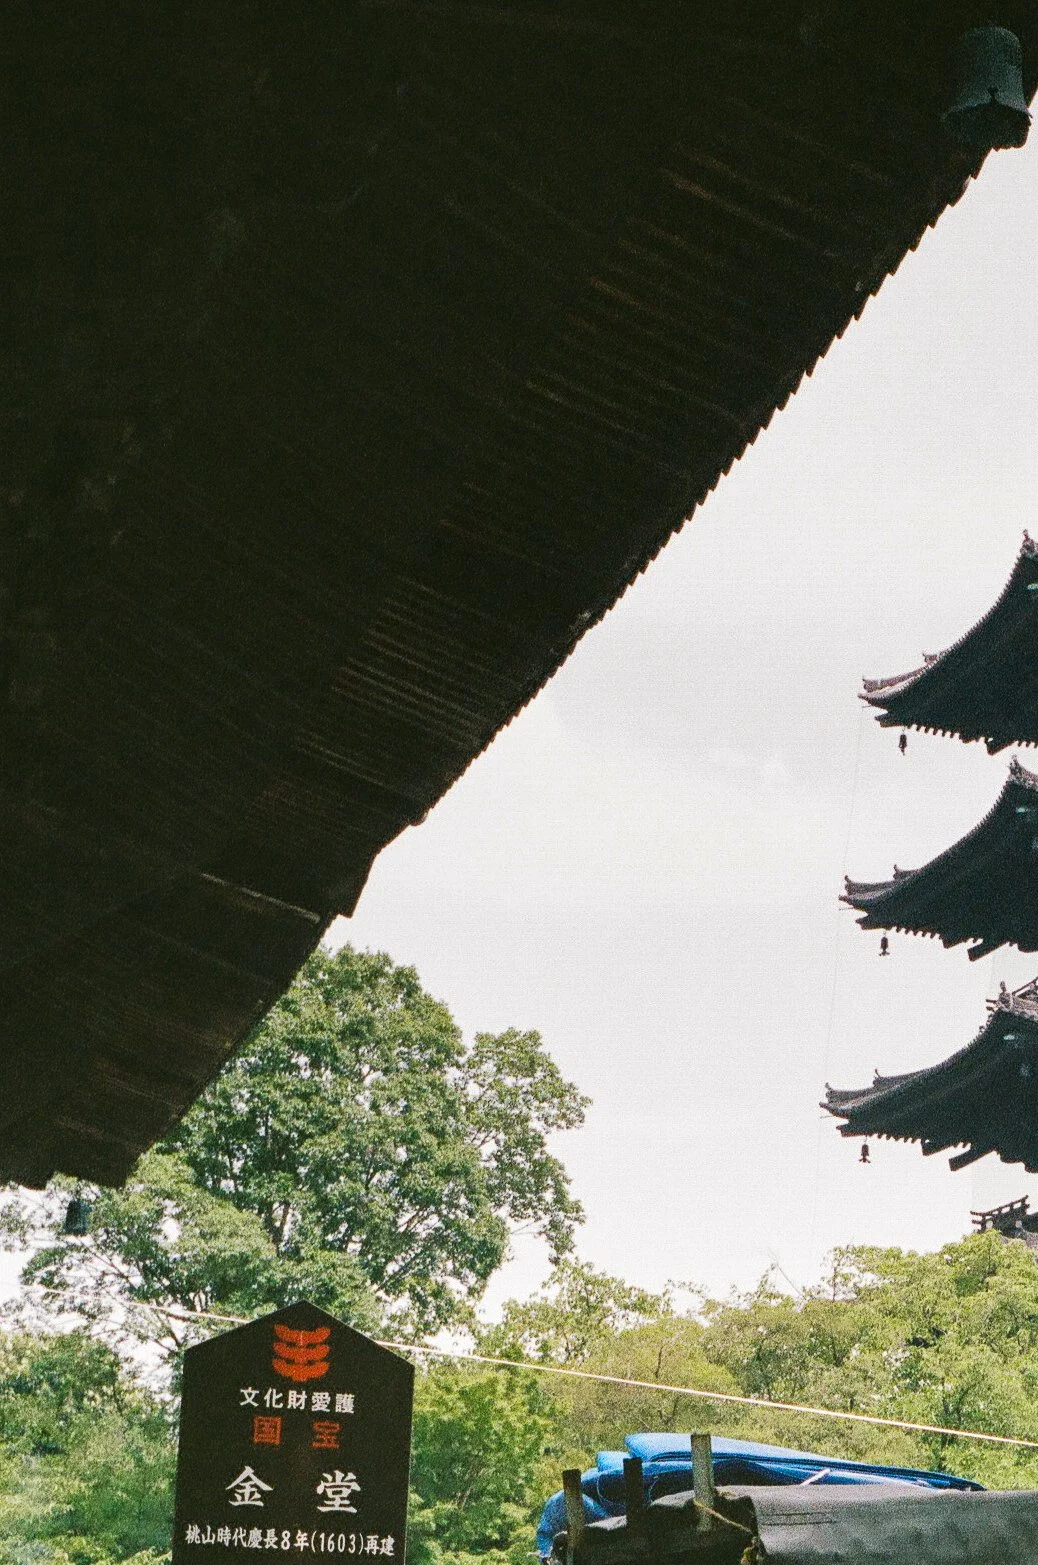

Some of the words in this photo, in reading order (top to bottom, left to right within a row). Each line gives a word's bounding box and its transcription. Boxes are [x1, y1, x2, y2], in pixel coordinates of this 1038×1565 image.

[240, 1387, 355, 1414] 文化財愛護
[253, 1416, 341, 1449] 国宝
[225, 1466, 361, 1513] 金堂
[185, 1524, 395, 1556] 桃山時代慶長8年(1603)再建
